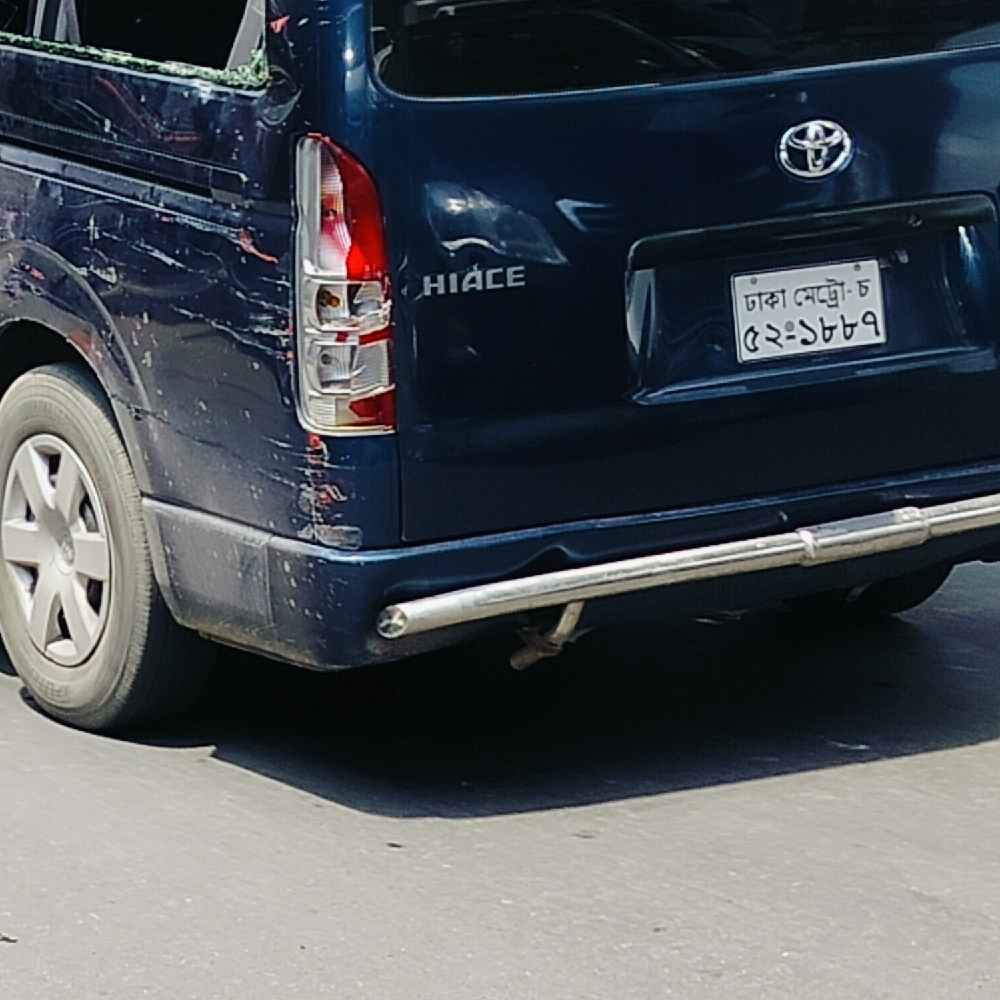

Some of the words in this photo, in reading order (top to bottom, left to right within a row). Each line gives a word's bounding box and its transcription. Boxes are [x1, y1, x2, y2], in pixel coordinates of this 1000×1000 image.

[423, 265, 526, 297] HIACE
[743, 288, 787, 312] ঢাকা
[743, 309, 881, 353] ৫২-১৮৮৭
